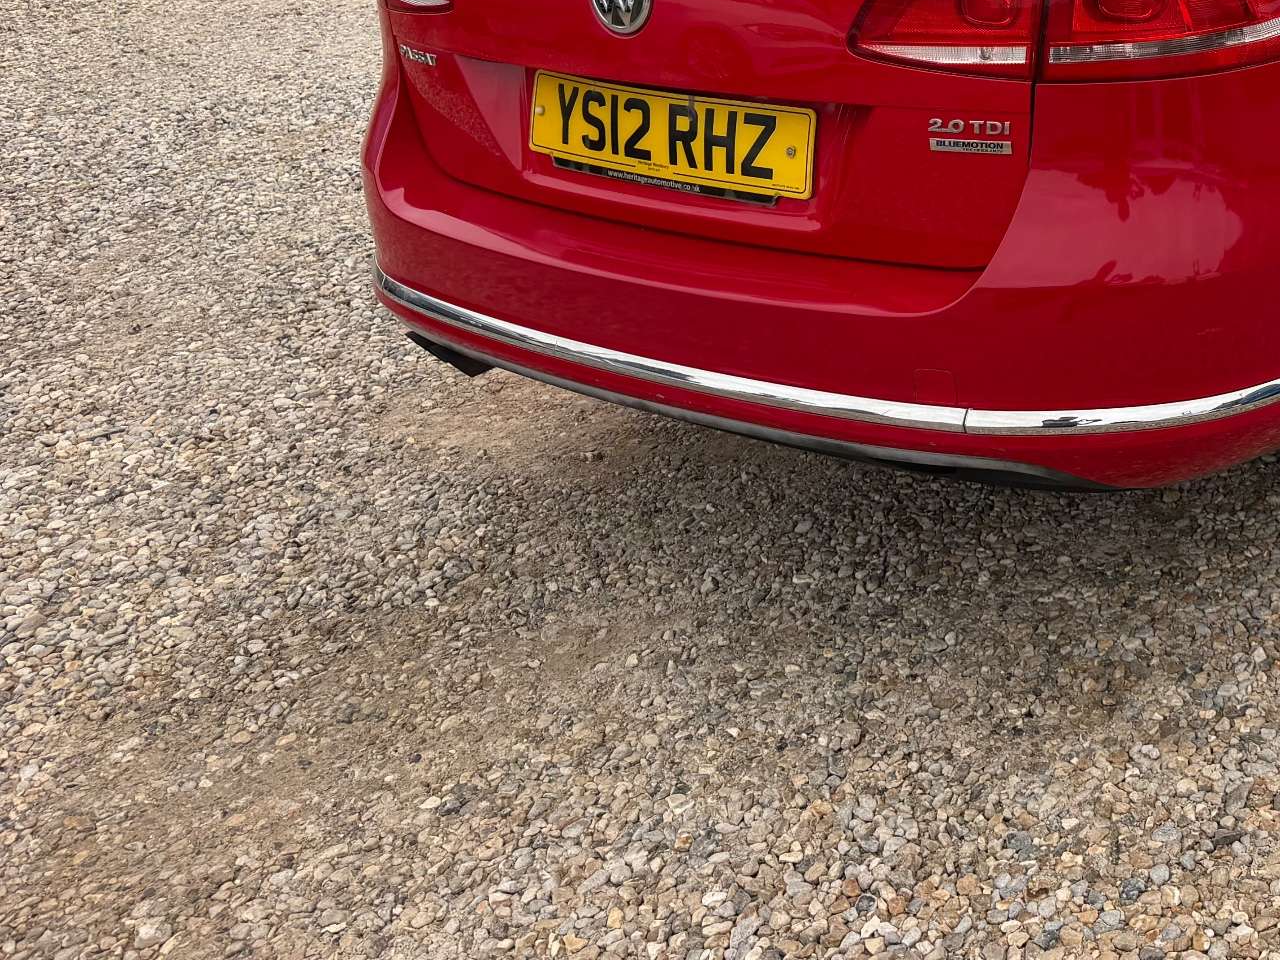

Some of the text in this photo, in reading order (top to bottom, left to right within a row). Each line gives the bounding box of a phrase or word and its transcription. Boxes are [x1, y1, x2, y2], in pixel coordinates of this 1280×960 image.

[558, 83, 777, 181] YS12 RHZ
[928, 118, 1011, 135] 2.0 TDI
[936, 139, 1004, 150] BLUEMOTION
